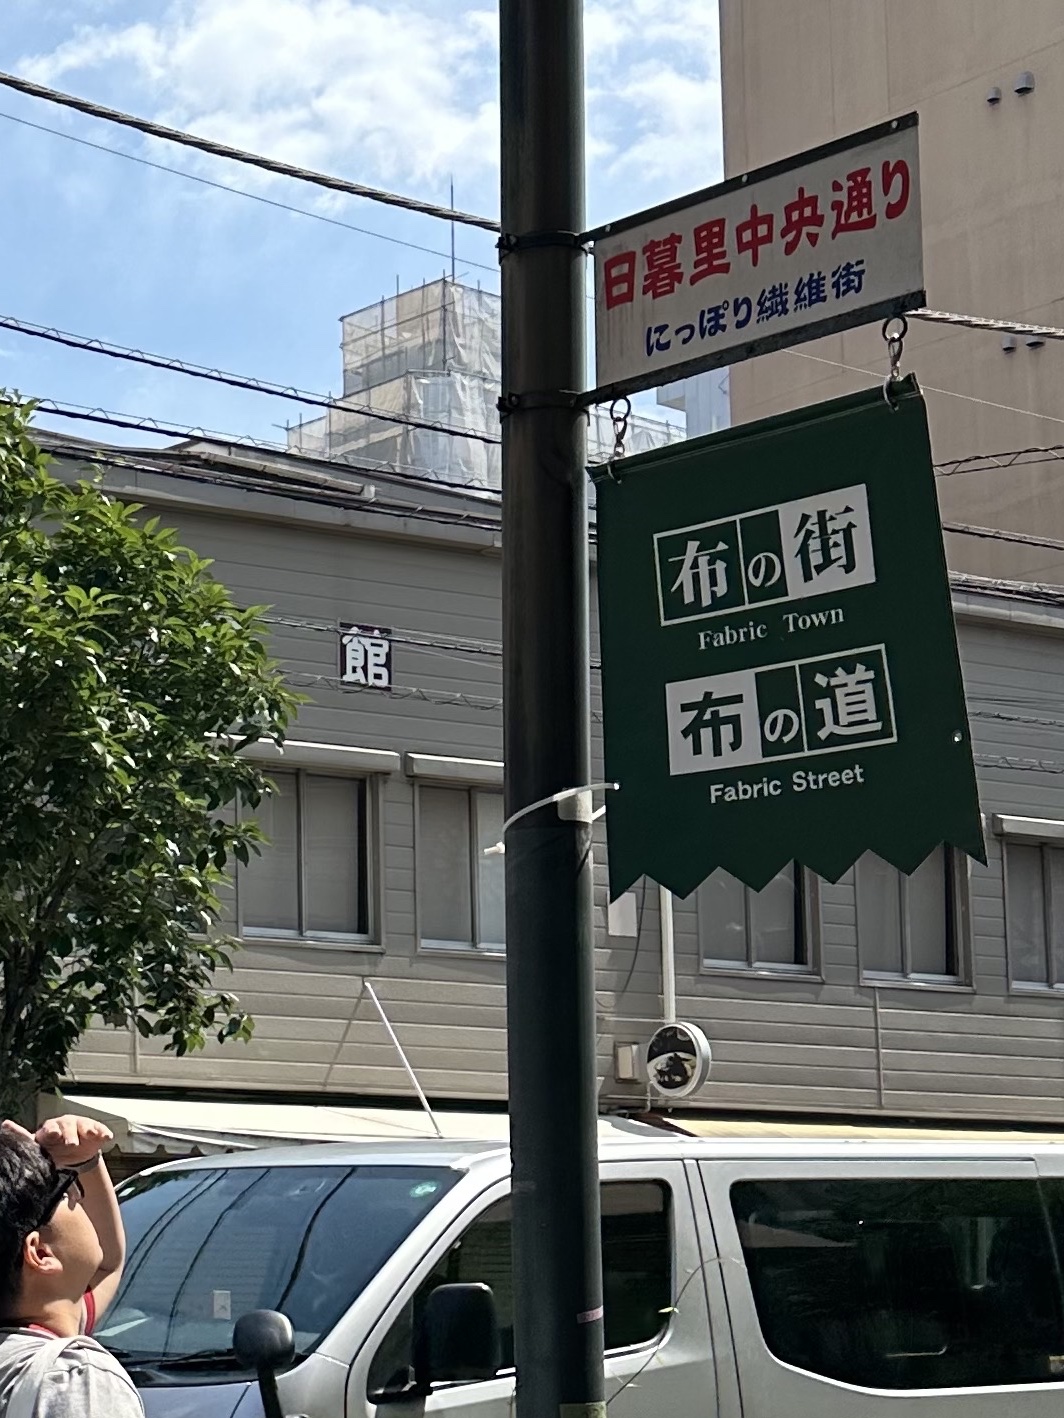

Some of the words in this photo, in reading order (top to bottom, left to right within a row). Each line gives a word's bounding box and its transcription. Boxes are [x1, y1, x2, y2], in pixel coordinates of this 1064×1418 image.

[604, 159, 910, 311] 日暮里中央通り
[645, 258, 866, 357] にっぽり繊維街
[667, 504, 858, 608] 布の街
[341, 626, 390, 687] 館
[697, 621, 768, 650] Fabric
[782, 607, 845, 634] Town
[679, 662, 883, 758] 布の道
[710, 777, 782, 804] Fabric
[792, 764, 865, 791] Street
